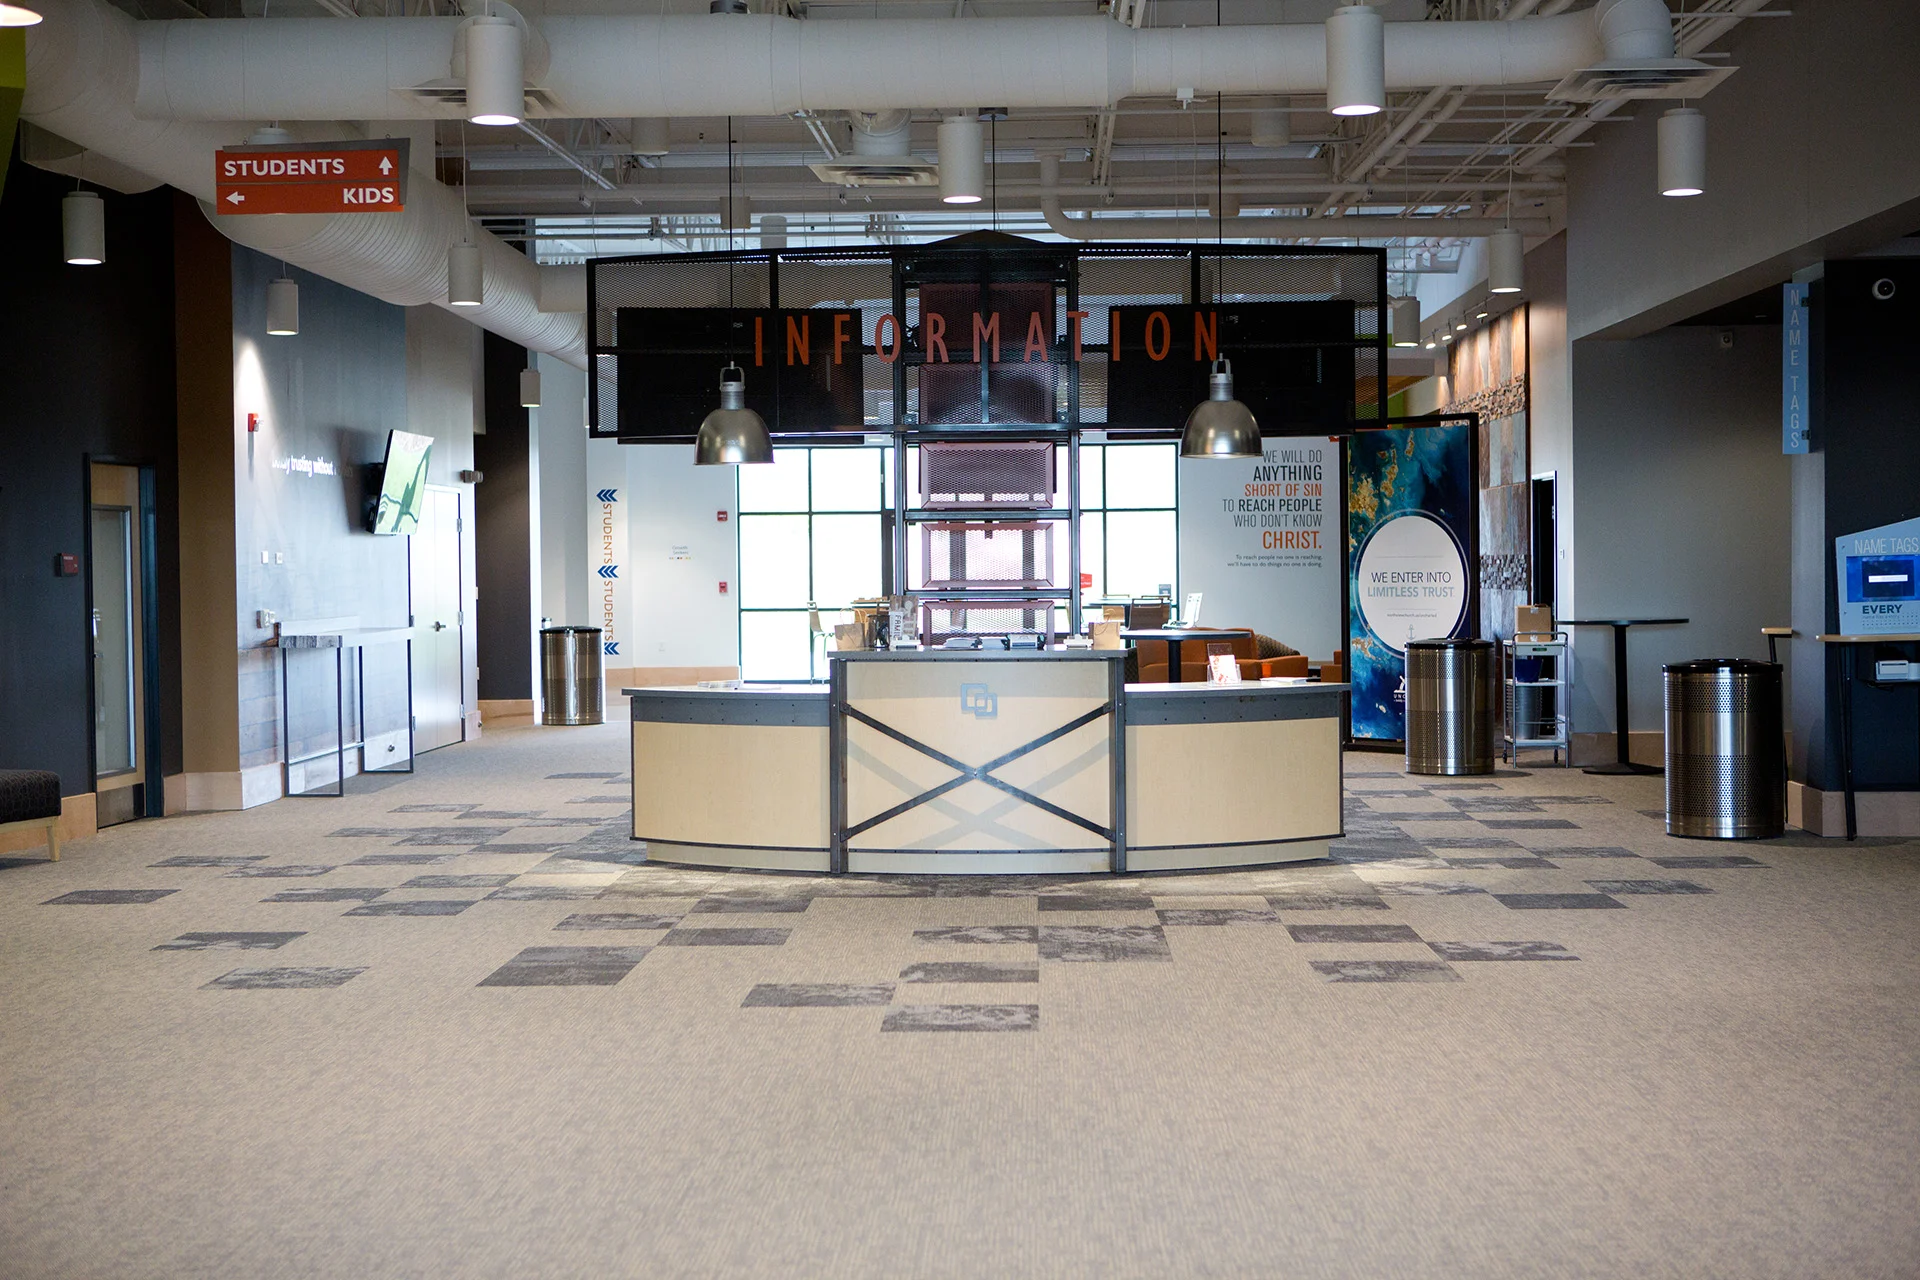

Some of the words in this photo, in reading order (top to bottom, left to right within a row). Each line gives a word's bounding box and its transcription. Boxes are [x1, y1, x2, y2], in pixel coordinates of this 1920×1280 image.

[224, 158, 345, 177] STUDENTS
[343, 187, 394, 204] KIDS
[1789, 289, 1801, 366] NAME
[754, 310, 1217, 366] INFORMATION
[1790, 375, 1800, 448] TAGS
[1263, 449, 1278, 463] WE
[1281, 449, 1305, 463] WILL
[1309, 449, 1322, 463] DO
[1253, 465, 1322, 481] ANYTHING
[1244, 483, 1281, 497] SHORT
[1285, 483, 1300, 497] OF
[1303, 483, 1322, 497] SIN
[1222, 499, 1235, 512] TO
[1238, 499, 1275, 512] REACH
[1279, 499, 1322, 512] PEOPLE
[1233, 514, 1257, 528] WHO
[1260, 514, 1289, 528] DON'T
[1292, 514, 1323, 528] KNOW
[602, 503, 613, 564] STUDENTS
[1262, 531, 1322, 550] CHRIST.
[1854, 538, 1887, 554] NAME
[1890, 537, 1919, 553] TAGS
[1258, 554, 1275, 562] people
[1371, 571, 1388, 583] WE
[1391, 571, 1424, 583] ENTER
[1426, 571, 1452, 583] INTO
[1367, 586, 1419, 598] LIMITLESS
[603, 580, 614, 641] STUDENTS
[1862, 604, 1903, 615] EVERY
